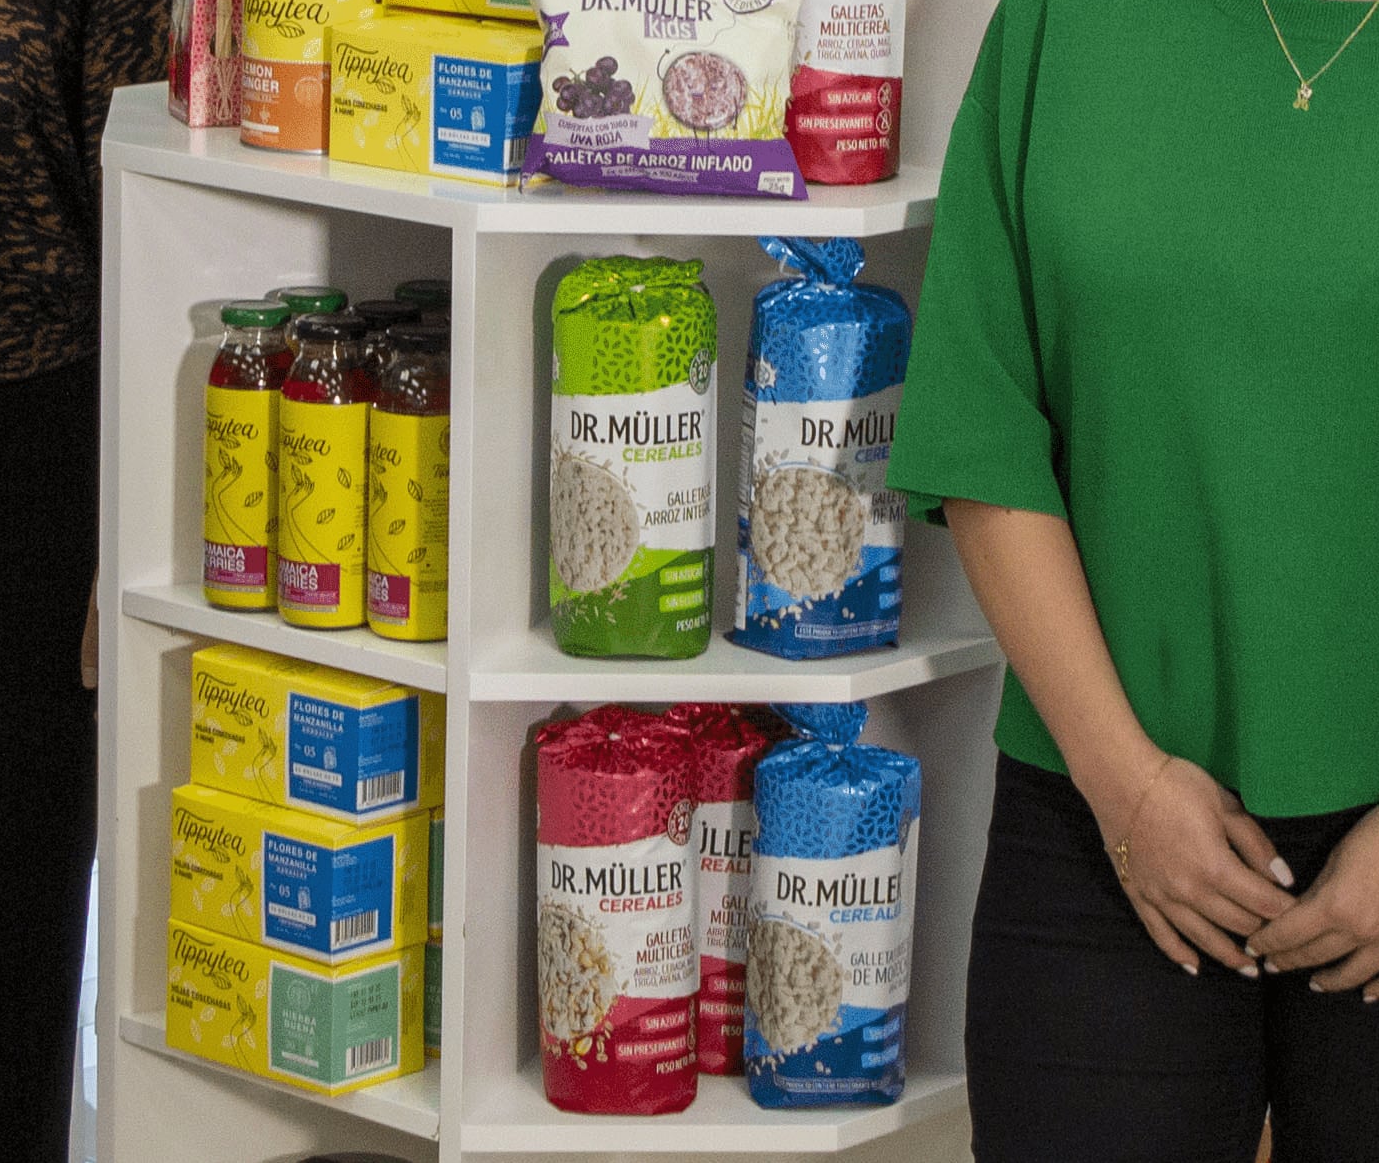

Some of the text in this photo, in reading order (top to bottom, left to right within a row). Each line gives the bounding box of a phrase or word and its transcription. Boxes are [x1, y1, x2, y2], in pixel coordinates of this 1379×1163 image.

[831, 4, 884, 20] GALLETAS
[336, 42, 413, 85] Tippytea
[439, 63, 492, 80] FLORES DE
[439, 76, 492, 91] MANZANILLA
[799, 117, 813, 128] SIN
[570, 131, 622, 146] UVA ROJA
[617, 154, 634, 165] DE
[638, 155, 686, 168] ARROZ
[691, 155, 752, 172] INFLADO
[571, 410, 701, 446] DR.MÜLLER
[623, 441, 702, 463] CEREALES
[645, 508, 680, 526] ARROZ
[196, 671, 270, 720] Tippytea
[294, 700, 345, 723] FLORES DE
[293, 713, 344, 734] MANZANILLA
[175, 807, 246, 857] Tippytea
[269, 840, 317, 862] FLORES DE
[268, 853, 317, 873] MANZANILLA
[551, 859, 683, 896] DR.MÜLLER
[599, 890, 683, 913] CEREALES
[646, 926, 692, 948] GALLETAS
[173, 928, 249, 983] Tippytea
[853, 969, 871, 986] DE
[645, 1018, 661, 1030] SIN
[722, 1026, 741, 1036] PESO
[618, 1044, 633, 1057] SIN
[656, 1060, 674, 1074] PESO
